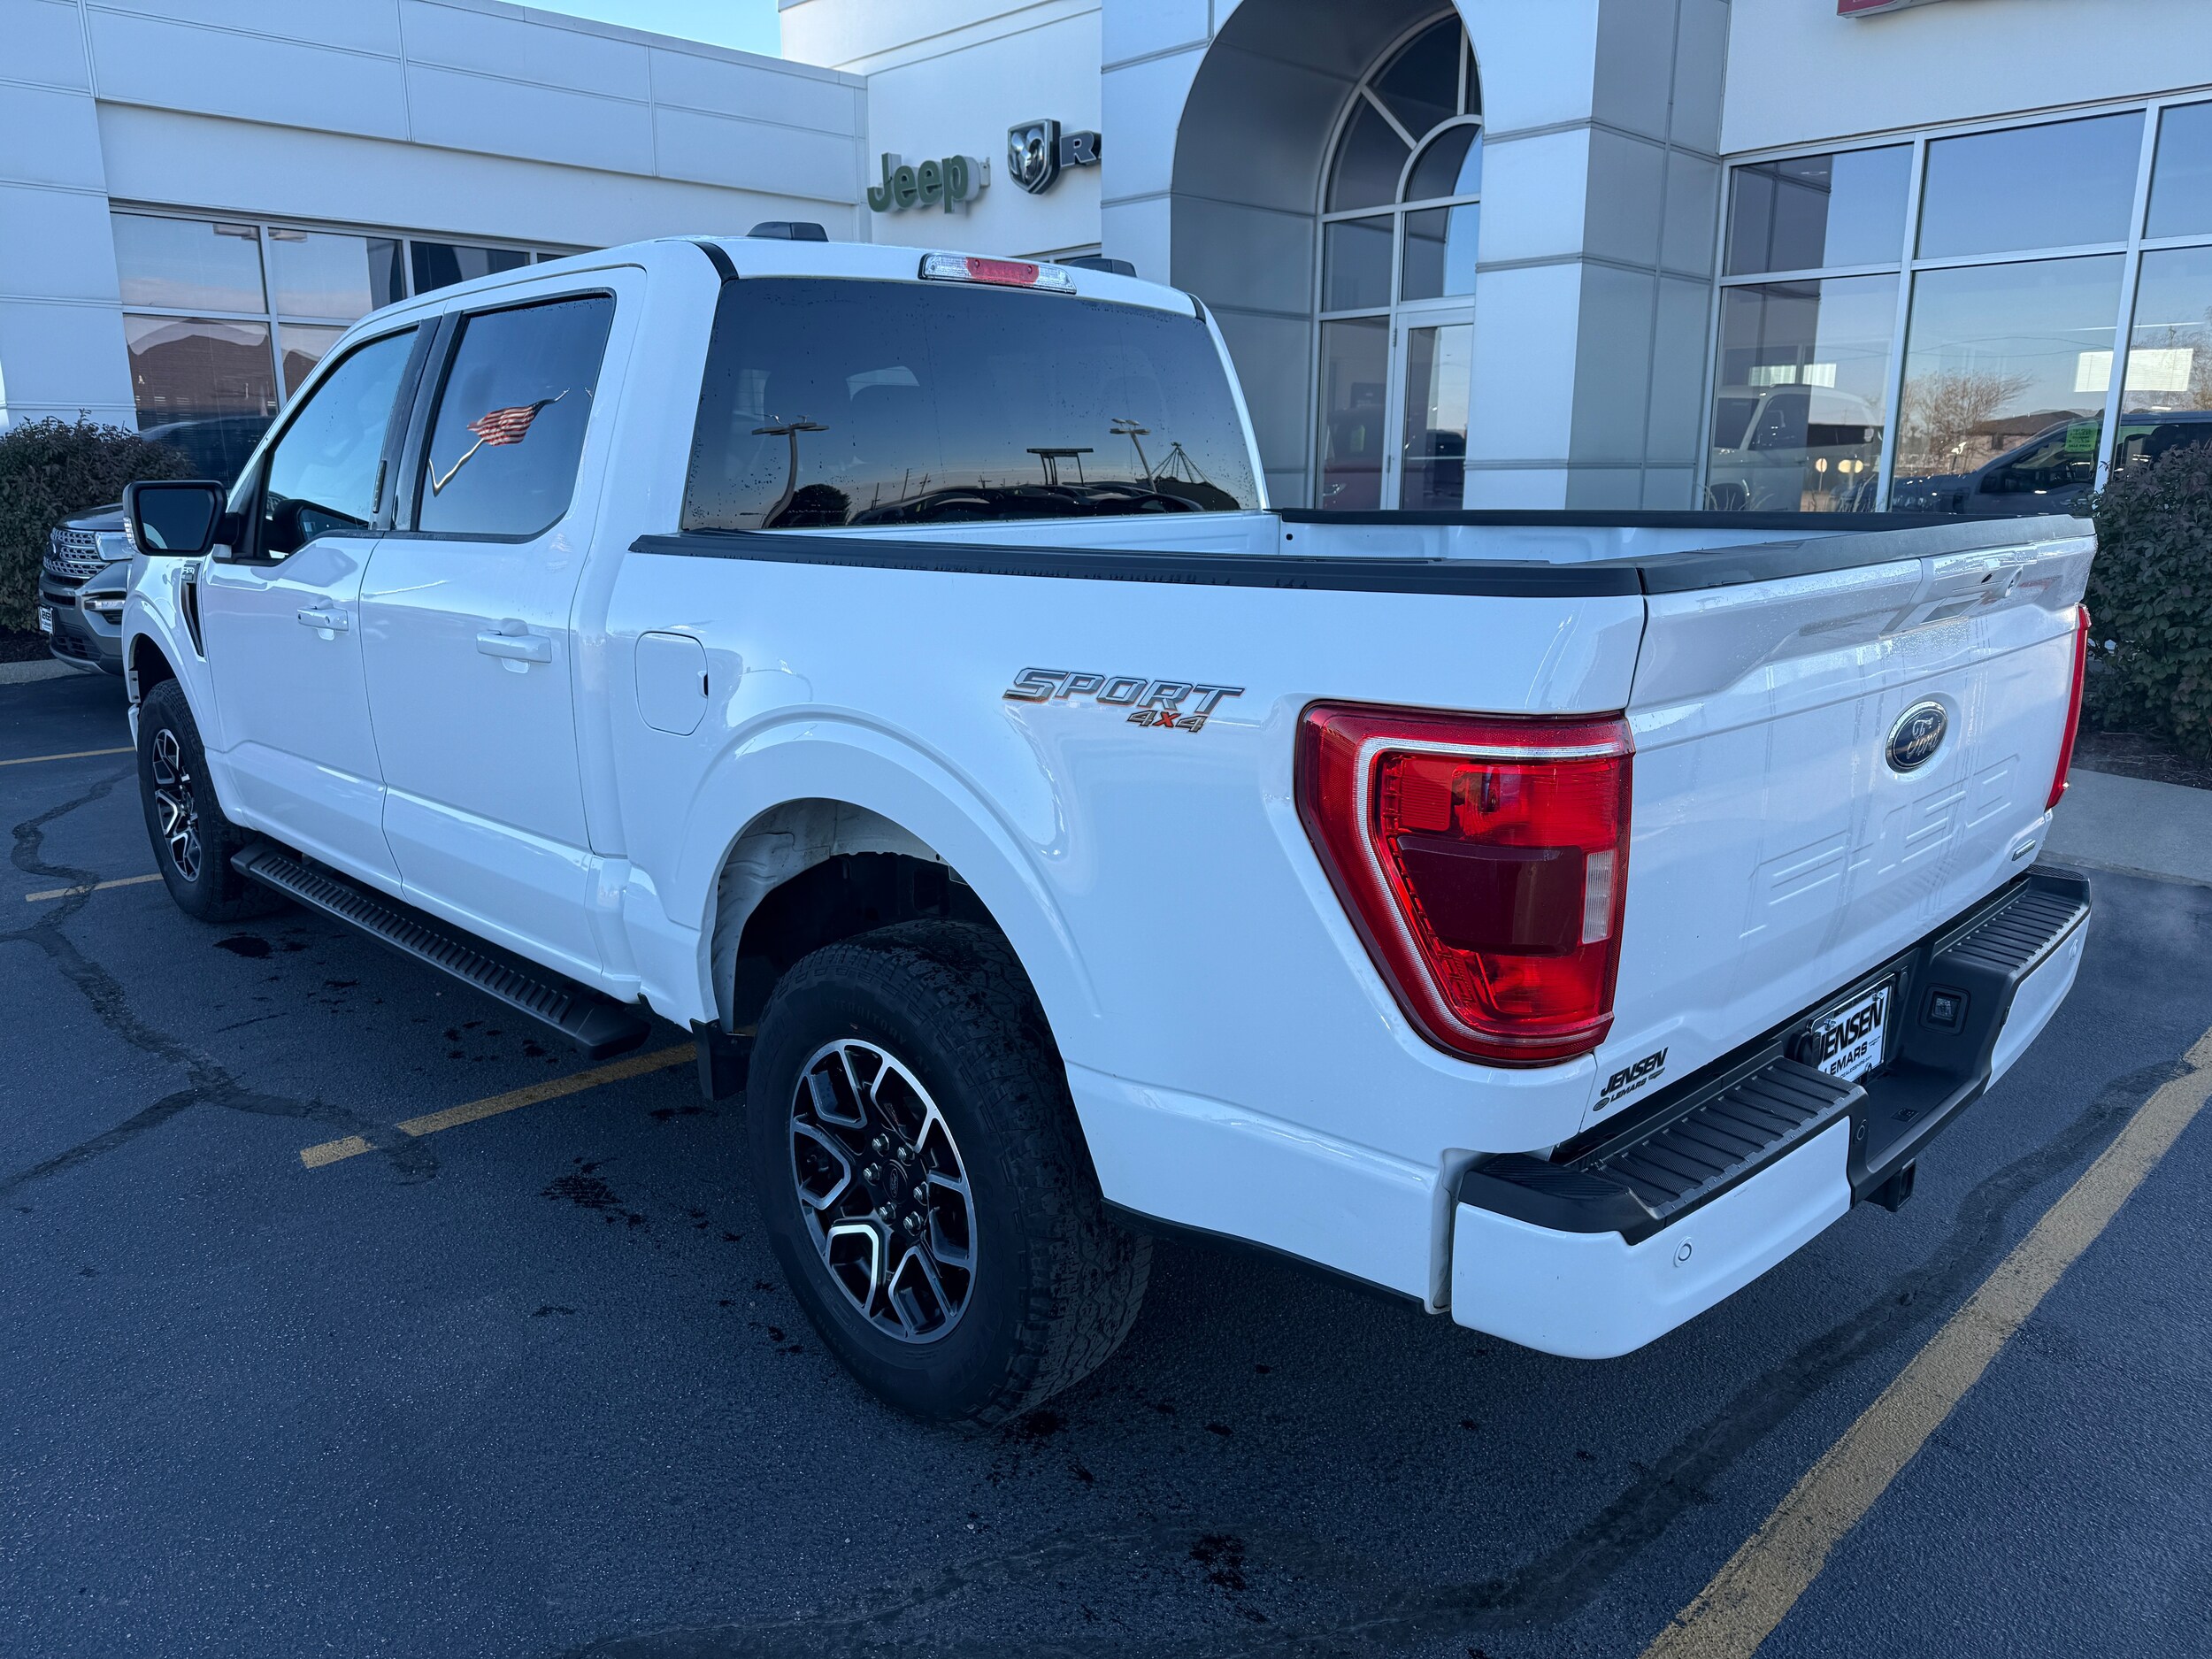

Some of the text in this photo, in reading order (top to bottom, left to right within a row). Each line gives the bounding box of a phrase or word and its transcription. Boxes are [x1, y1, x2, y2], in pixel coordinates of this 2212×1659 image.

[866, 152, 979, 213] Jeep
[1002, 667, 1245, 715] SPORT
[1906, 718, 1940, 760] Ford
[1601, 1047, 1668, 1097] JENSEN
